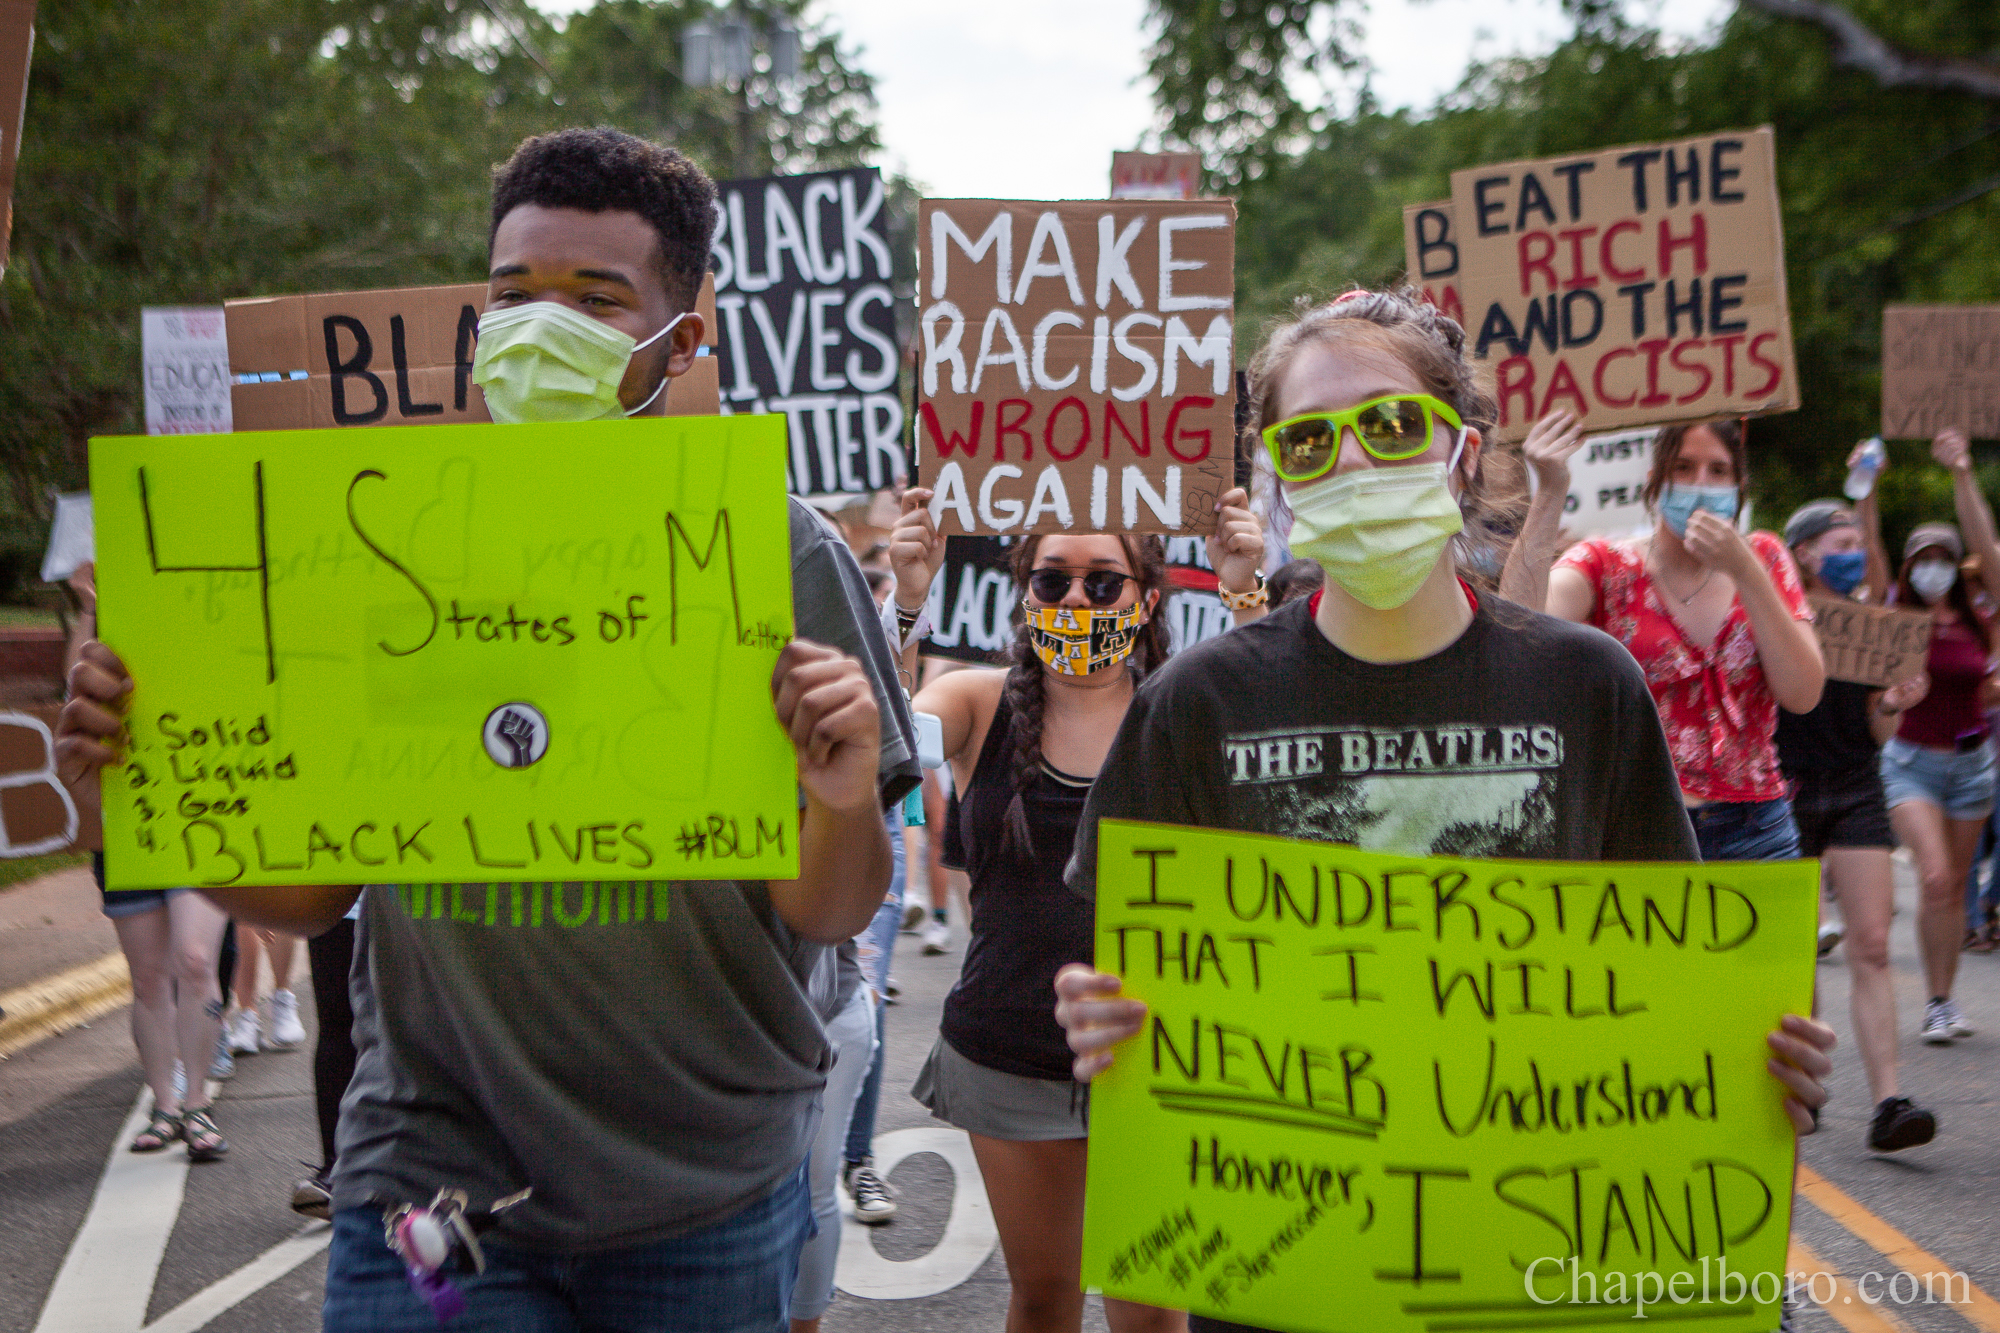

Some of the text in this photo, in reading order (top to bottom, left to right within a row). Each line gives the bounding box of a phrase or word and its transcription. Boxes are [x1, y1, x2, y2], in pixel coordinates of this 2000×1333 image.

[1474, 140, 1746, 238] EAT THE
[931, 210, 1232, 312] MAKE
[1517, 212, 1709, 297] RICH
[719, 283, 898, 400] IVES
[922, 301, 1232, 402] RACISM
[1473, 273, 1748, 360] AND THE
[1496, 331, 1782, 428] RACISTS
[720, 393, 909, 497] TTER
[920, 395, 1215, 464] WRONG
[1586, 436, 1654, 465] JUST
[928, 461, 1182, 533] AGAIN
[1181, 454, 1234, 533] #BLM
[136, 459, 275, 686] 4
[346, 468, 576, 658] States
[597, 594, 649, 643] of
[928, 562, 1018, 656] LACK
[156, 712, 272, 750] Solid
[169, 752, 298, 793] Liquid
[1226, 725, 1559, 782] THE BEATLES
[180, 818, 436, 886] BLACK
[464, 814, 655, 869] LIVES
[674, 815, 787, 863] #BLM
[1125, 846, 1759, 953] I UNDERSTAND
[1103, 923, 1652, 1024] THAT I WILL
[1151, 1012, 1719, 1138] NEVER Understand
[1189, 1134, 1774, 1287] However, I STAND
